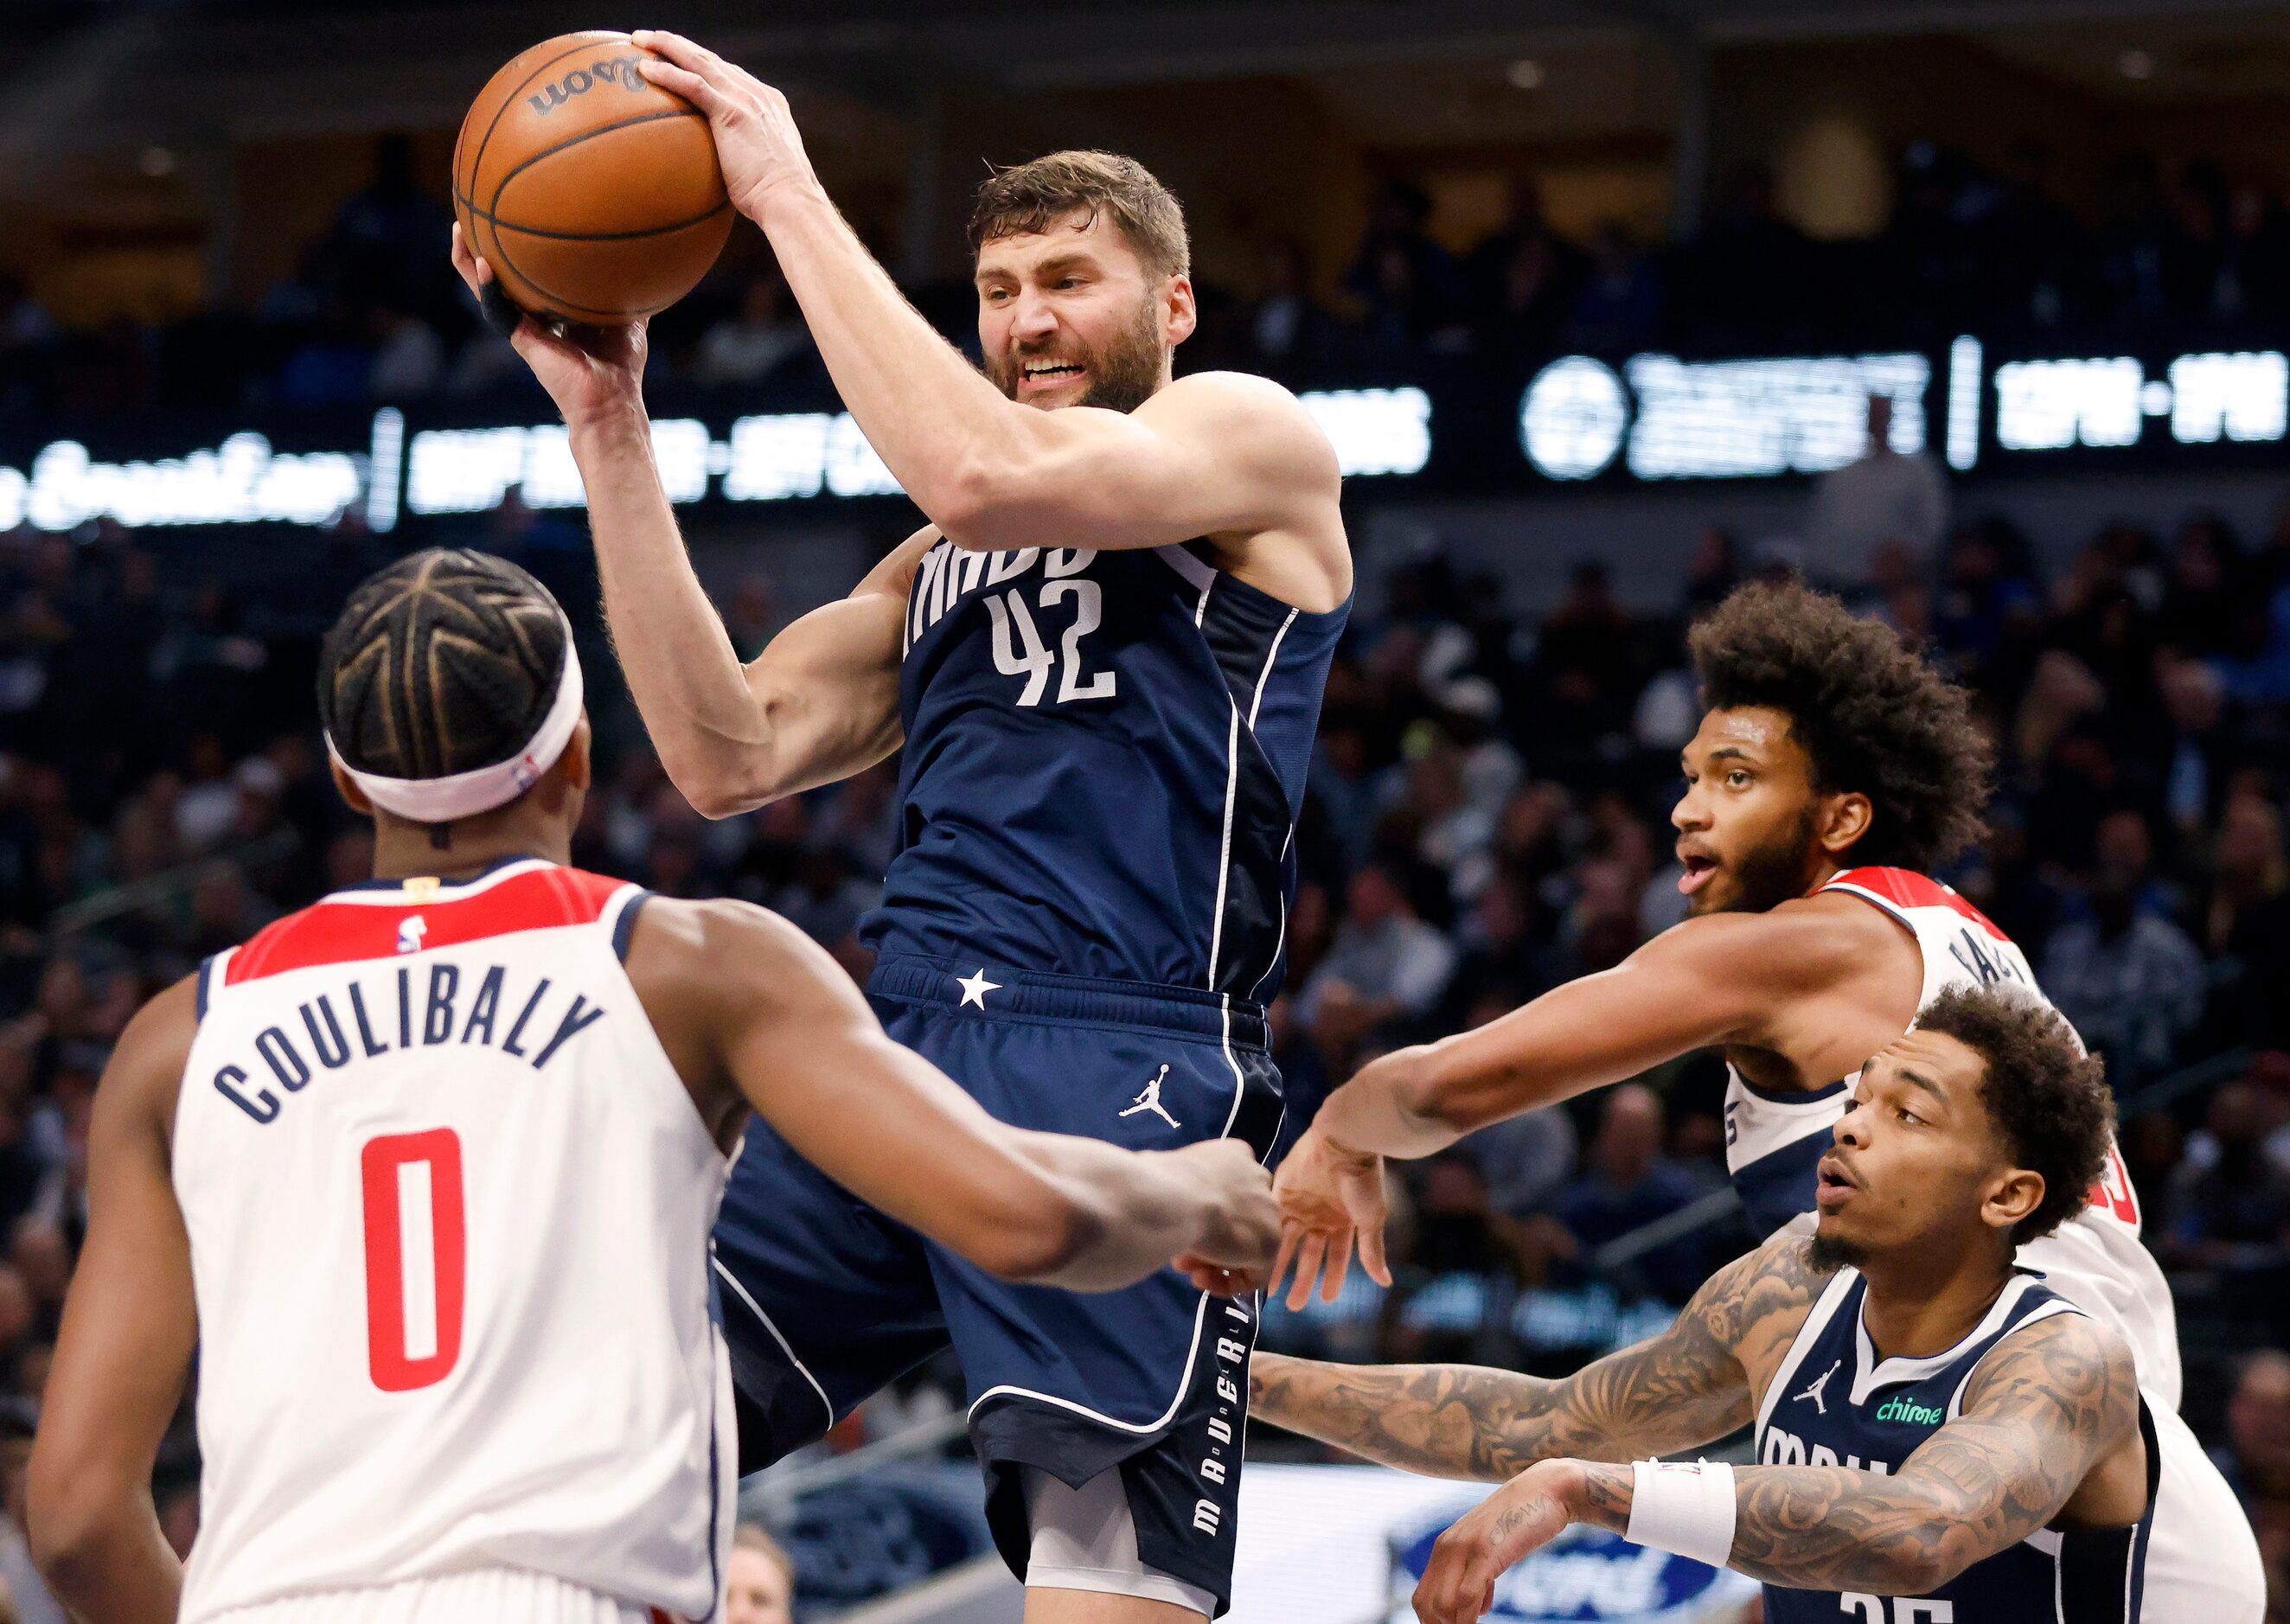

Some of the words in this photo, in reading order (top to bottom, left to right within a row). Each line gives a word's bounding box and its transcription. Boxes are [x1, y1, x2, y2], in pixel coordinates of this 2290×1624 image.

[982, 579, 1116, 707] 42
[213, 963, 606, 1124] COULIBALY
[361, 1126, 467, 1391] 0
[1877, 1396, 1942, 1425] chime
